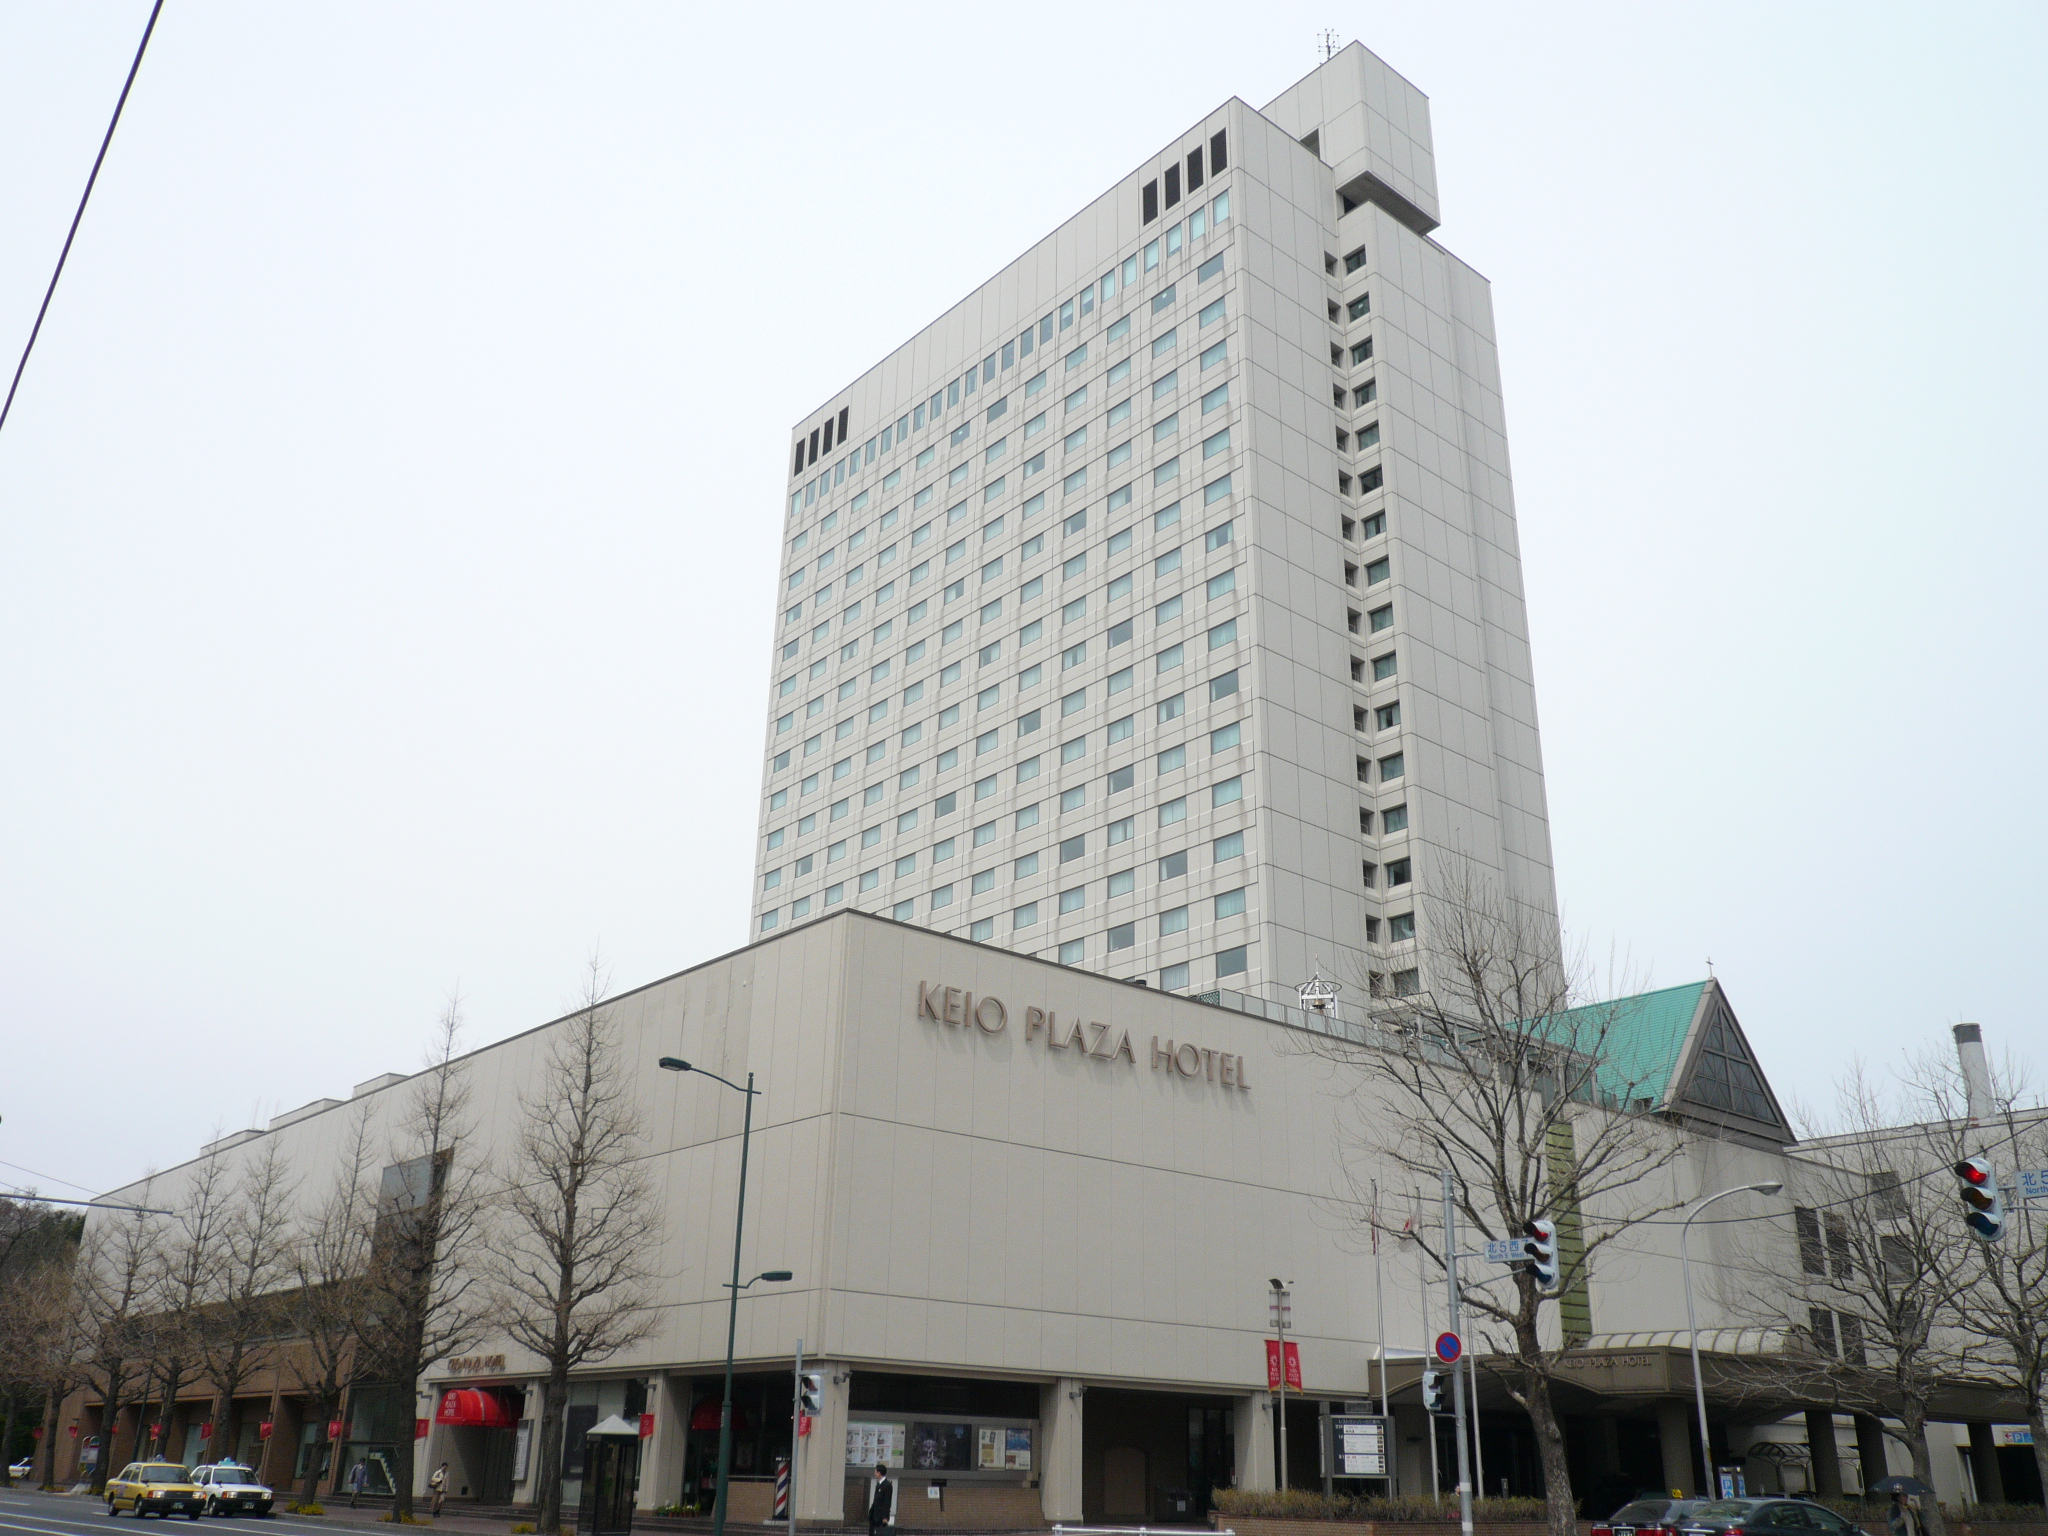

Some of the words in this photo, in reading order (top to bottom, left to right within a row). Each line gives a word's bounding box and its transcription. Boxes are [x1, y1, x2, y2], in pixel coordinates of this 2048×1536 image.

[918, 980, 1008, 1034] KEIO
[1026, 1005, 1137, 1064] PLAZA
[1151, 1035, 1252, 1090] HOTEL
[1488, 1253, 1504, 1261] North
[1510, 1251, 1525, 1259] West
[1590, 1356, 1618, 1368] PLAZA
[1621, 1355, 1652, 1367] HOTEL
